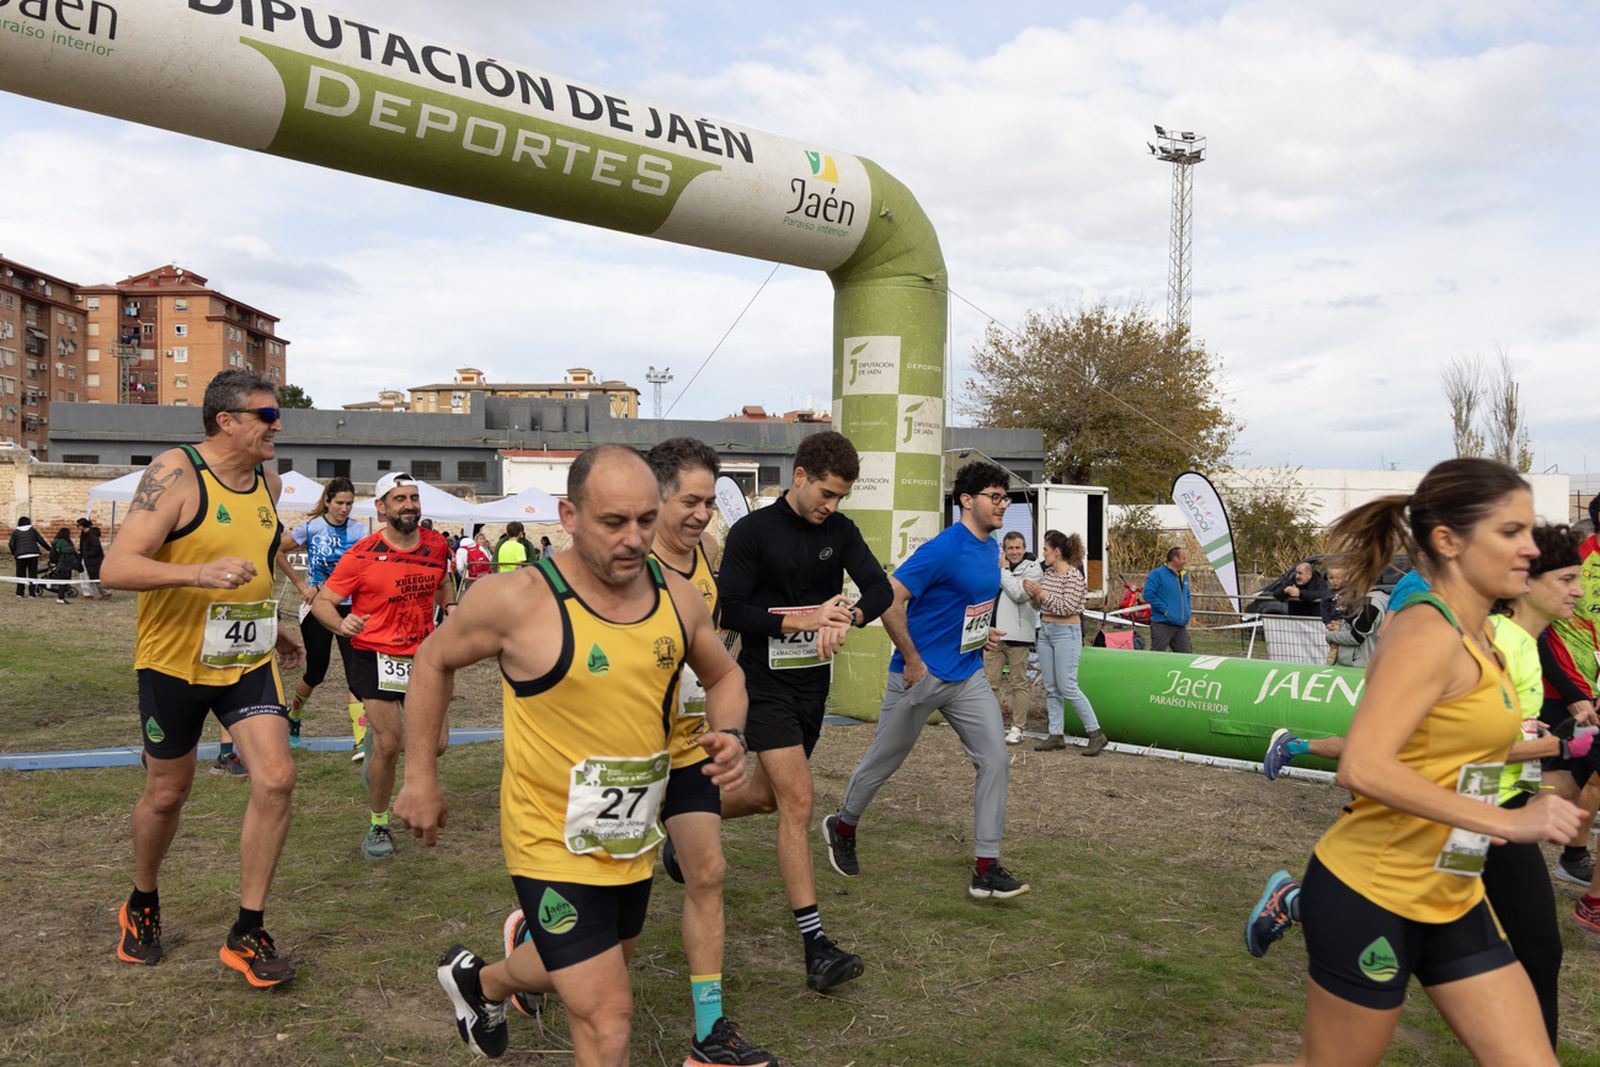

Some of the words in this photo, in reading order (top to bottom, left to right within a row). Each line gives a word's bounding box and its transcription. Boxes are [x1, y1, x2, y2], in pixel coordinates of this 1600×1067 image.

[51, 30, 114, 57] interior
[303, 64, 673, 197] DEPORTES
[566, 84, 633, 131] DE
[645, 107, 754, 164] JAÉN
[786, 177, 855, 227] Jaén
[782, 215, 815, 231] Paraíso
[816, 223, 849, 238] interior
[858, 361, 895, 369] DIPUTACIÓN
[225, 621, 257, 643] 40
[1161, 670, 1222, 700] Jaén
[1254, 668, 1365, 706] JAÉN
[1149, 694, 1186, 708] PARAÍSO
[1187, 699, 1230, 714] INTERIOR
[596, 786, 648, 820] 27
